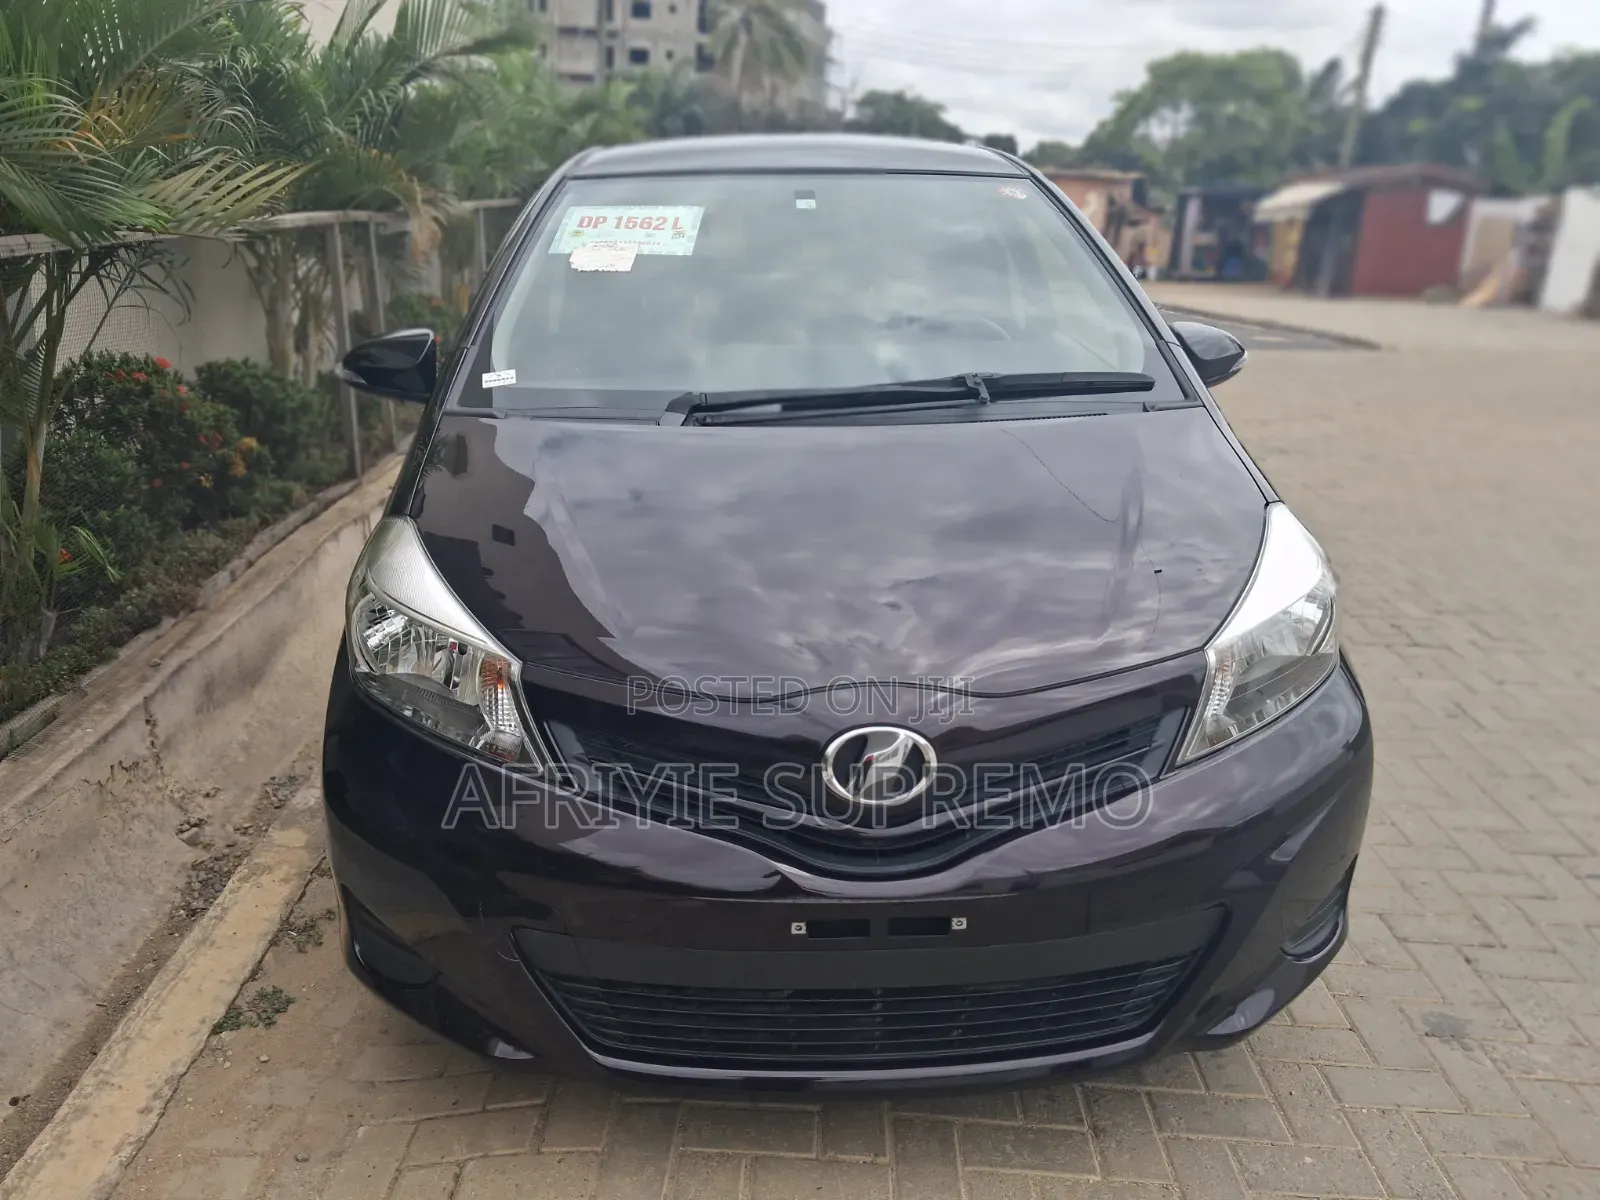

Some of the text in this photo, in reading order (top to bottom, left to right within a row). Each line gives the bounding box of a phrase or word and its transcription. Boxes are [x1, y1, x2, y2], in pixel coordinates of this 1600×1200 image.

[577, 215, 684, 231] DP 1562 L
